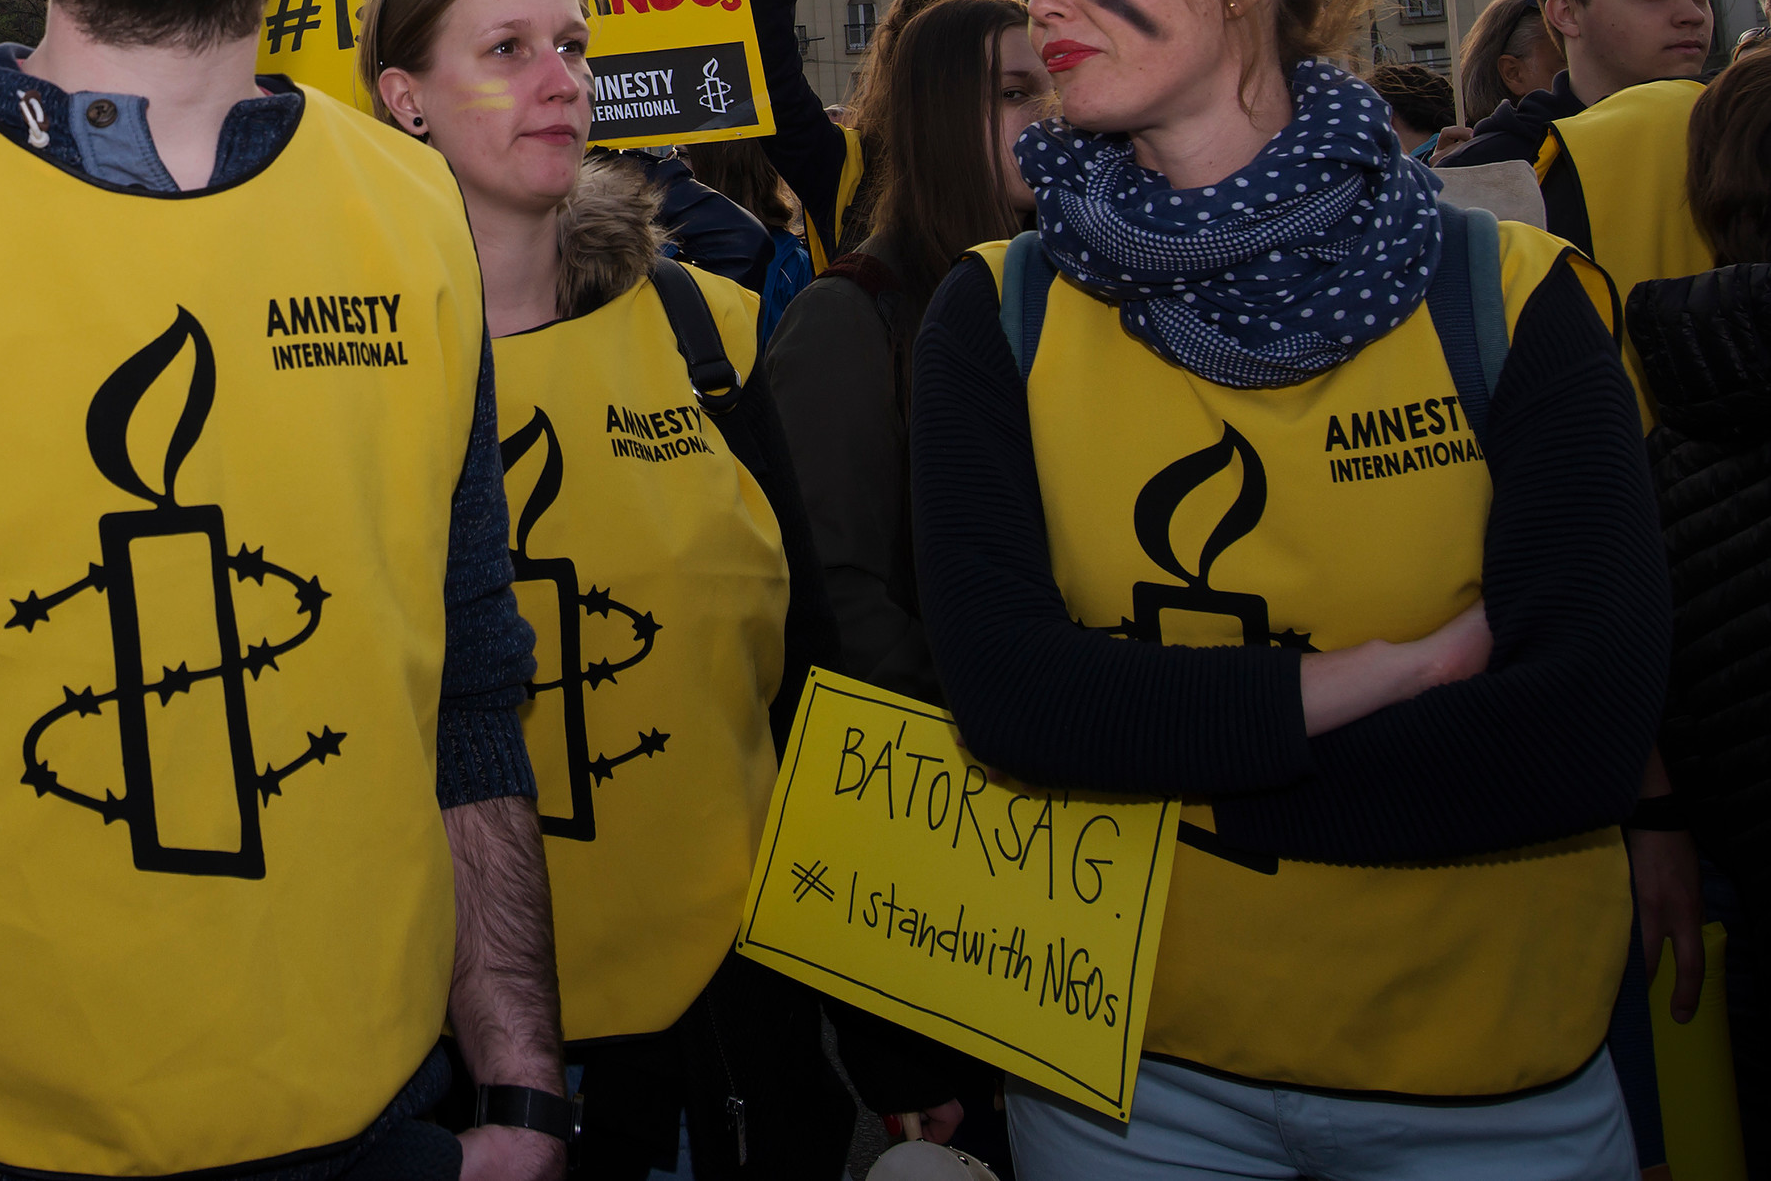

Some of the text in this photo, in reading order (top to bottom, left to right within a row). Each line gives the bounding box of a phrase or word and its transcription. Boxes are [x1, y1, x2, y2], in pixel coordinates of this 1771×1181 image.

[594, 69, 674, 102] MNESTY
[267, 294, 402, 338] AMNESTY
[272, 341, 409, 371] INTERNATIONAL
[606, 404, 702, 440] AMNESTY
